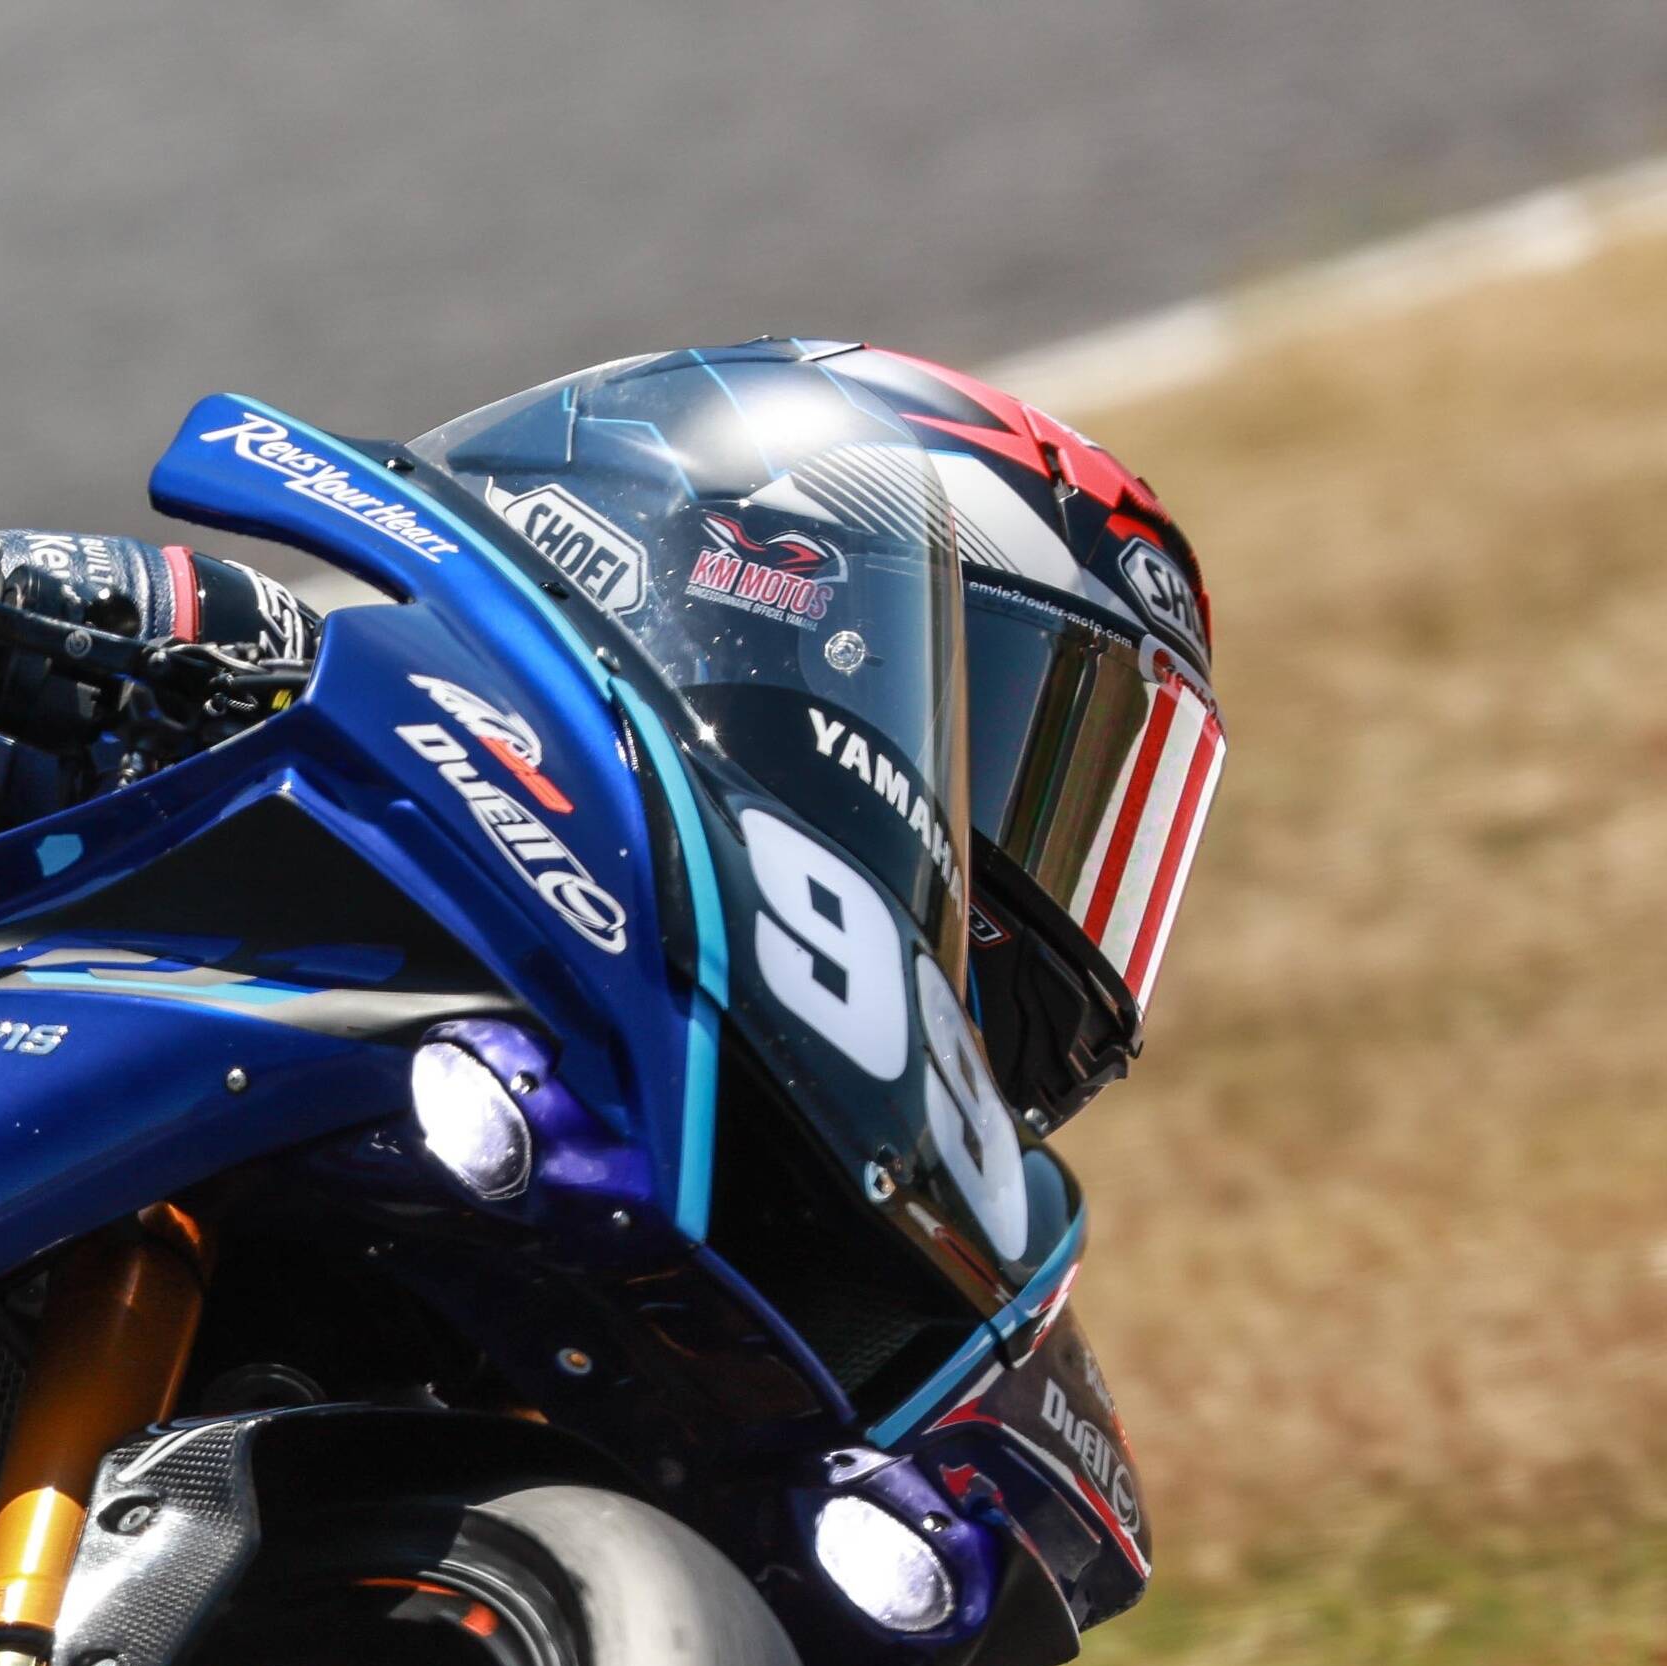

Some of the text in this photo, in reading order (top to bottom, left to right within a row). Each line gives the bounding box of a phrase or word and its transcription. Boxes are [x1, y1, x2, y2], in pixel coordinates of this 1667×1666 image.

[199, 411, 459, 555] Revs Your Heart
[524, 502, 629, 603] SHOEI
[689, 549, 834, 620] KM MOTOS
[807, 707, 964, 922] YAMAHA
